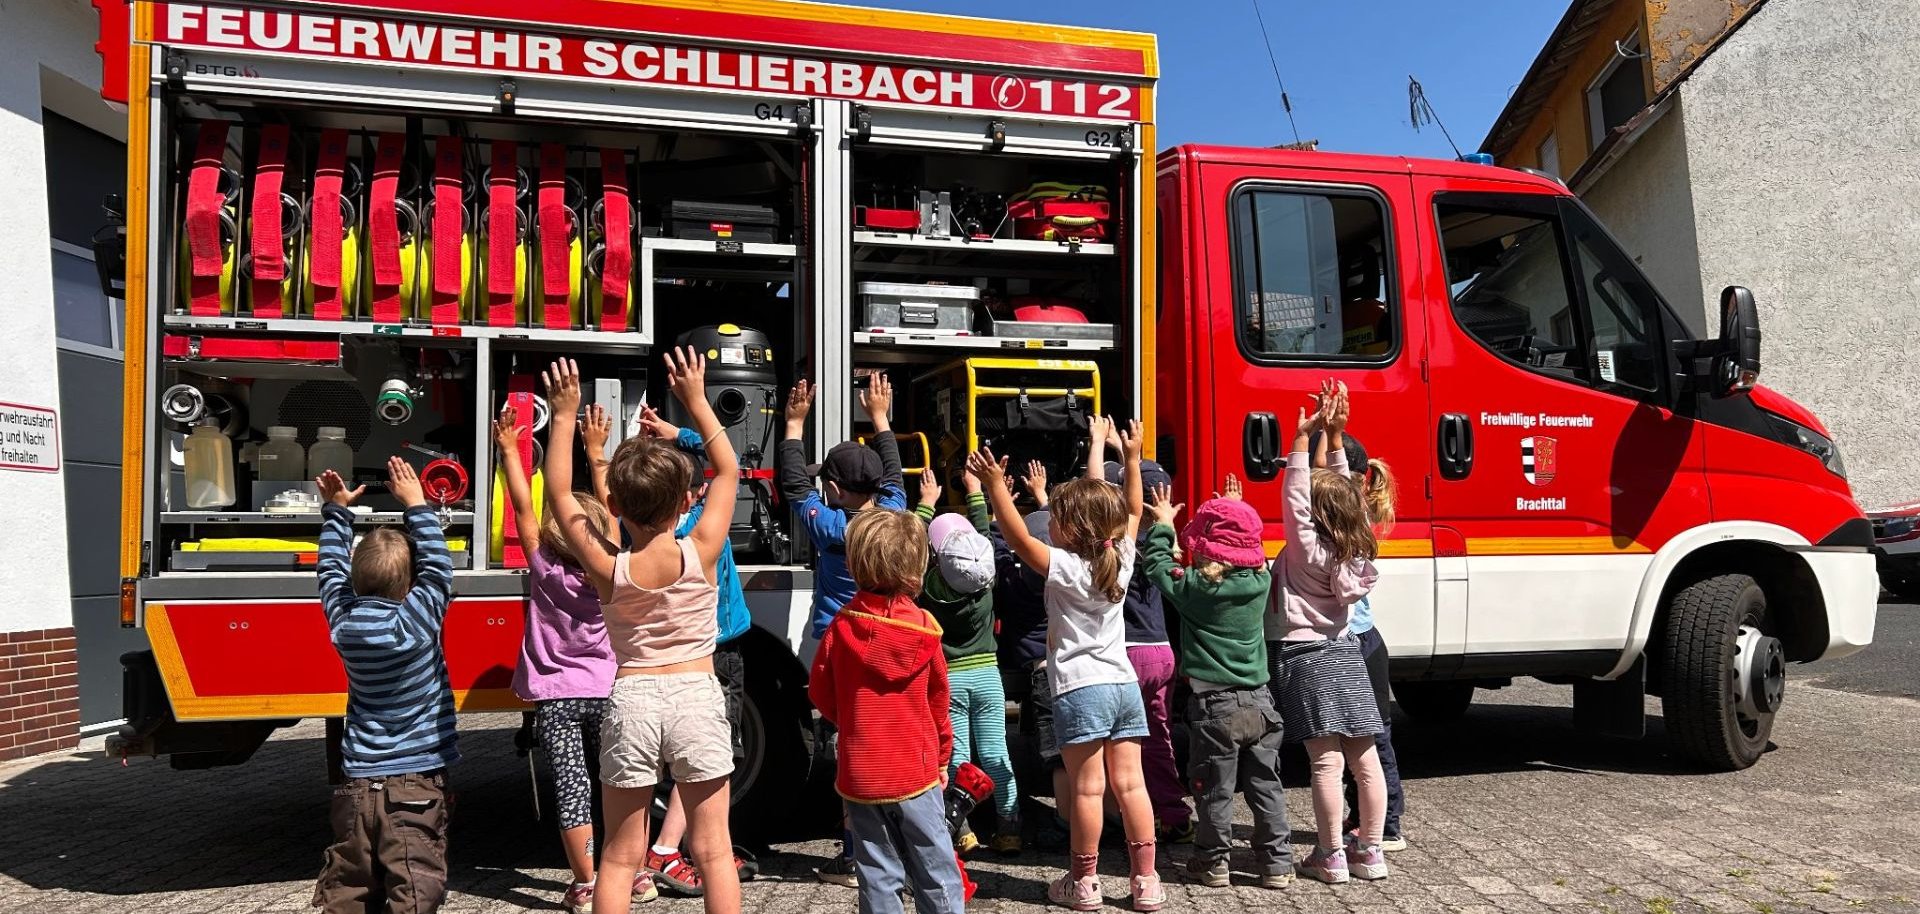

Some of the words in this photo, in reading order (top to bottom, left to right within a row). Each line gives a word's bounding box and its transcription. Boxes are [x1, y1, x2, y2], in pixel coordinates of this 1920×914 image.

[166, 3, 563, 71] FEUERWEHR
[582, 40, 973, 106] SCHLIERBACH
[1028, 80, 1134, 118] 112
[195, 63, 237, 77] BTG
[754, 102, 785, 121] G4
[1085, 130, 1111, 147] G2
[1480, 411, 1537, 429] Freiwillige
[1538, 413, 1594, 428] Feuerwehr
[6, 430, 21, 444] und
[23, 430, 46, 446] Nacht
[1, 447, 39, 464] freihalten
[1516, 496, 1566, 511] Brachttal
